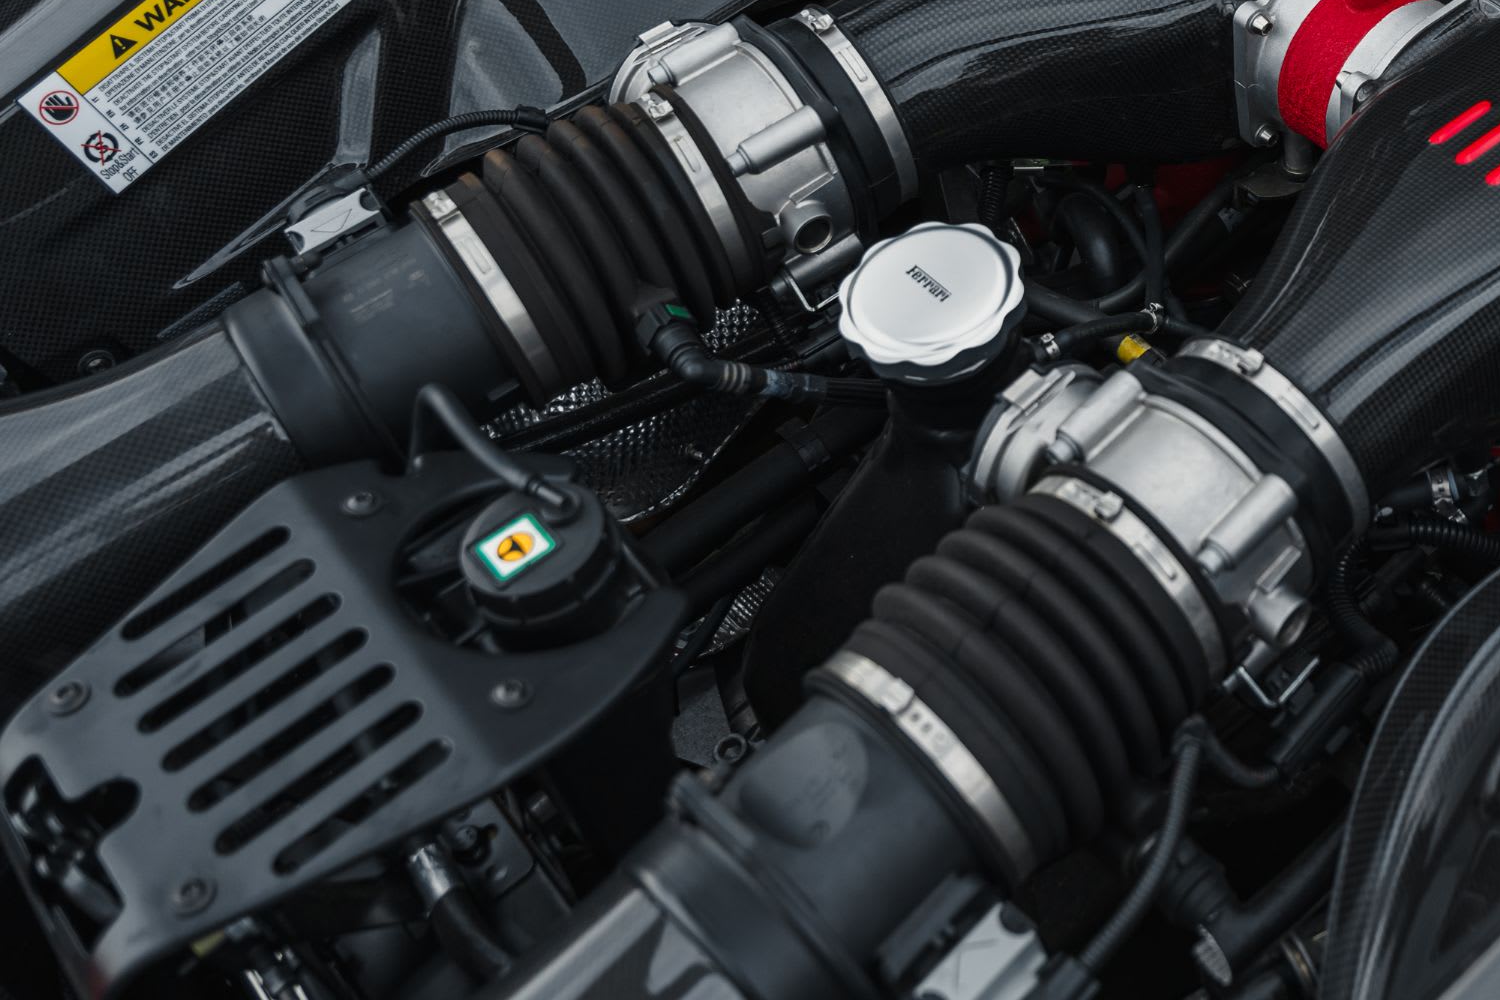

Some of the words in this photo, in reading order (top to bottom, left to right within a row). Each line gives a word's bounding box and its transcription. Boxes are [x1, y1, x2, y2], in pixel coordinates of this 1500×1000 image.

[112, 80, 144, 105] DEACTIVATE
[141, 73, 152, 83] THE
[150, 48, 183, 75] STOP&START
[180, 32, 202, 51] SYSTEM
[199, 19, 219, 36] BEFORE
[217, 0, 244, 21] CARRYING
[98, 145, 141, 181] Stop&Start
[122, 164, 140, 185] OFF
[905, 264, 952, 302] Ferrari
